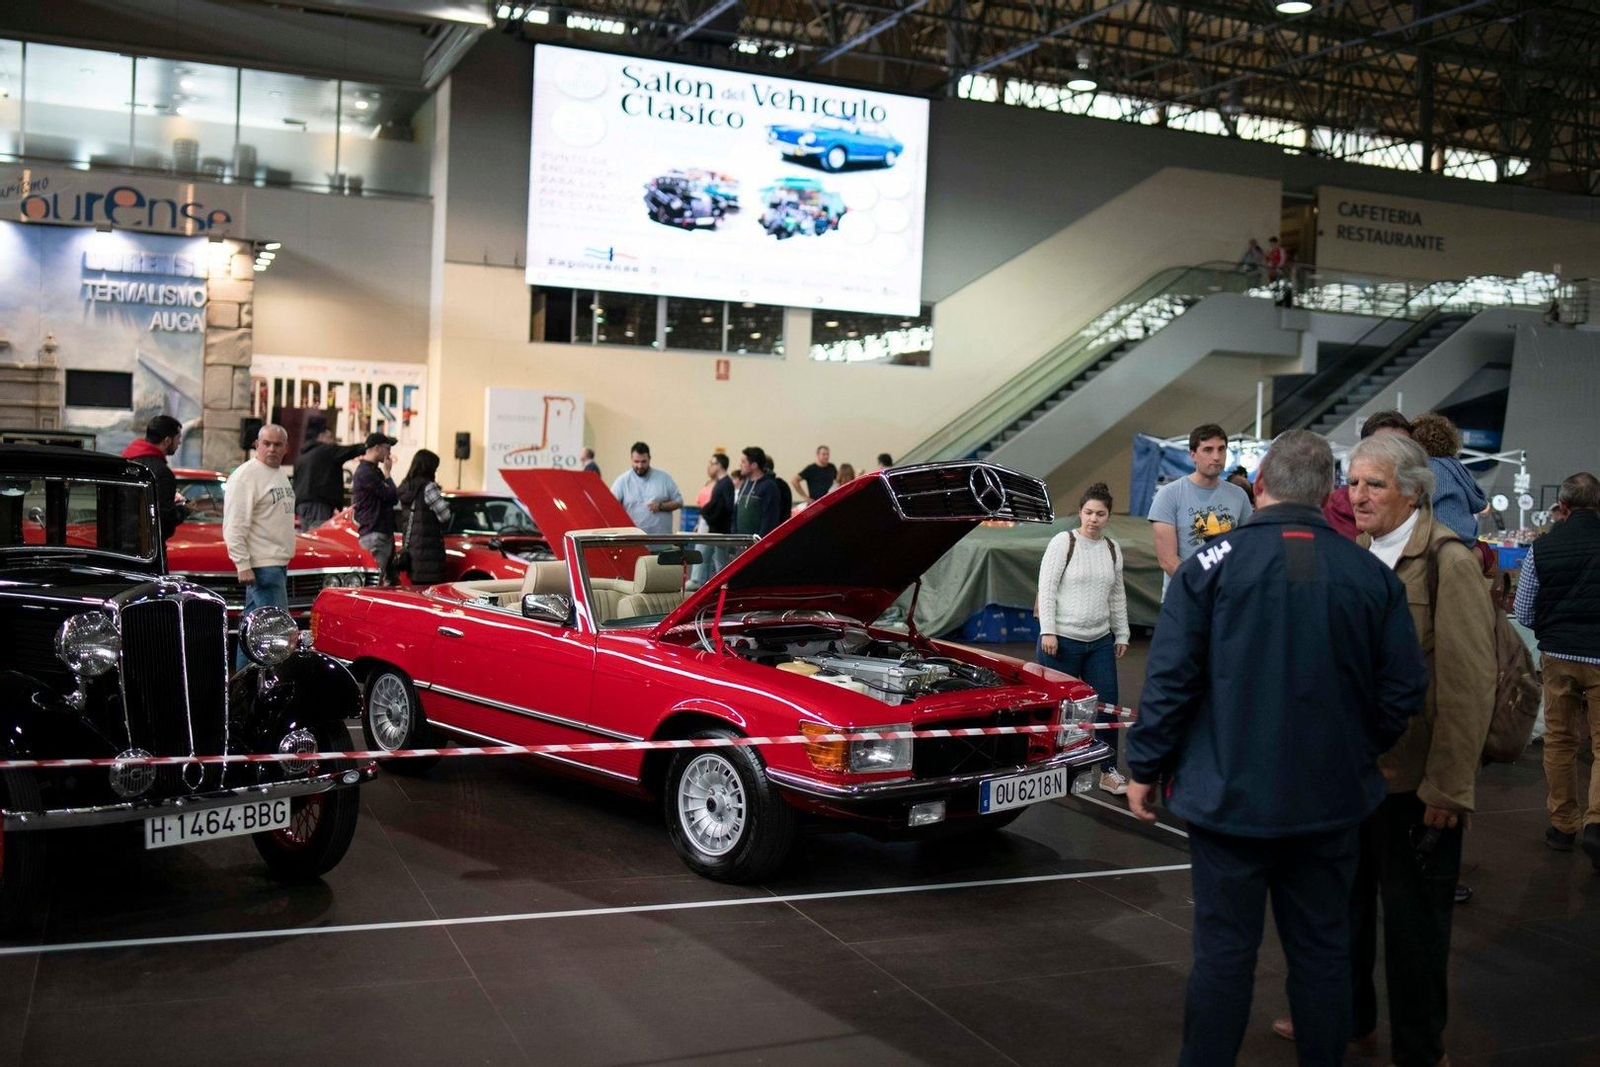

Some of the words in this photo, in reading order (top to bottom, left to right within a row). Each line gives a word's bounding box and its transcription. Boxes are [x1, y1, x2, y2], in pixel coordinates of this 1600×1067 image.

[0, 177, 49, 198] urismo
[1337, 201, 1423, 226] CAFETERIA
[1336, 224, 1445, 252] RESTAURANTE
[83, 279, 208, 308] TERMALISMO
[1197, 540, 1232, 571] HH
